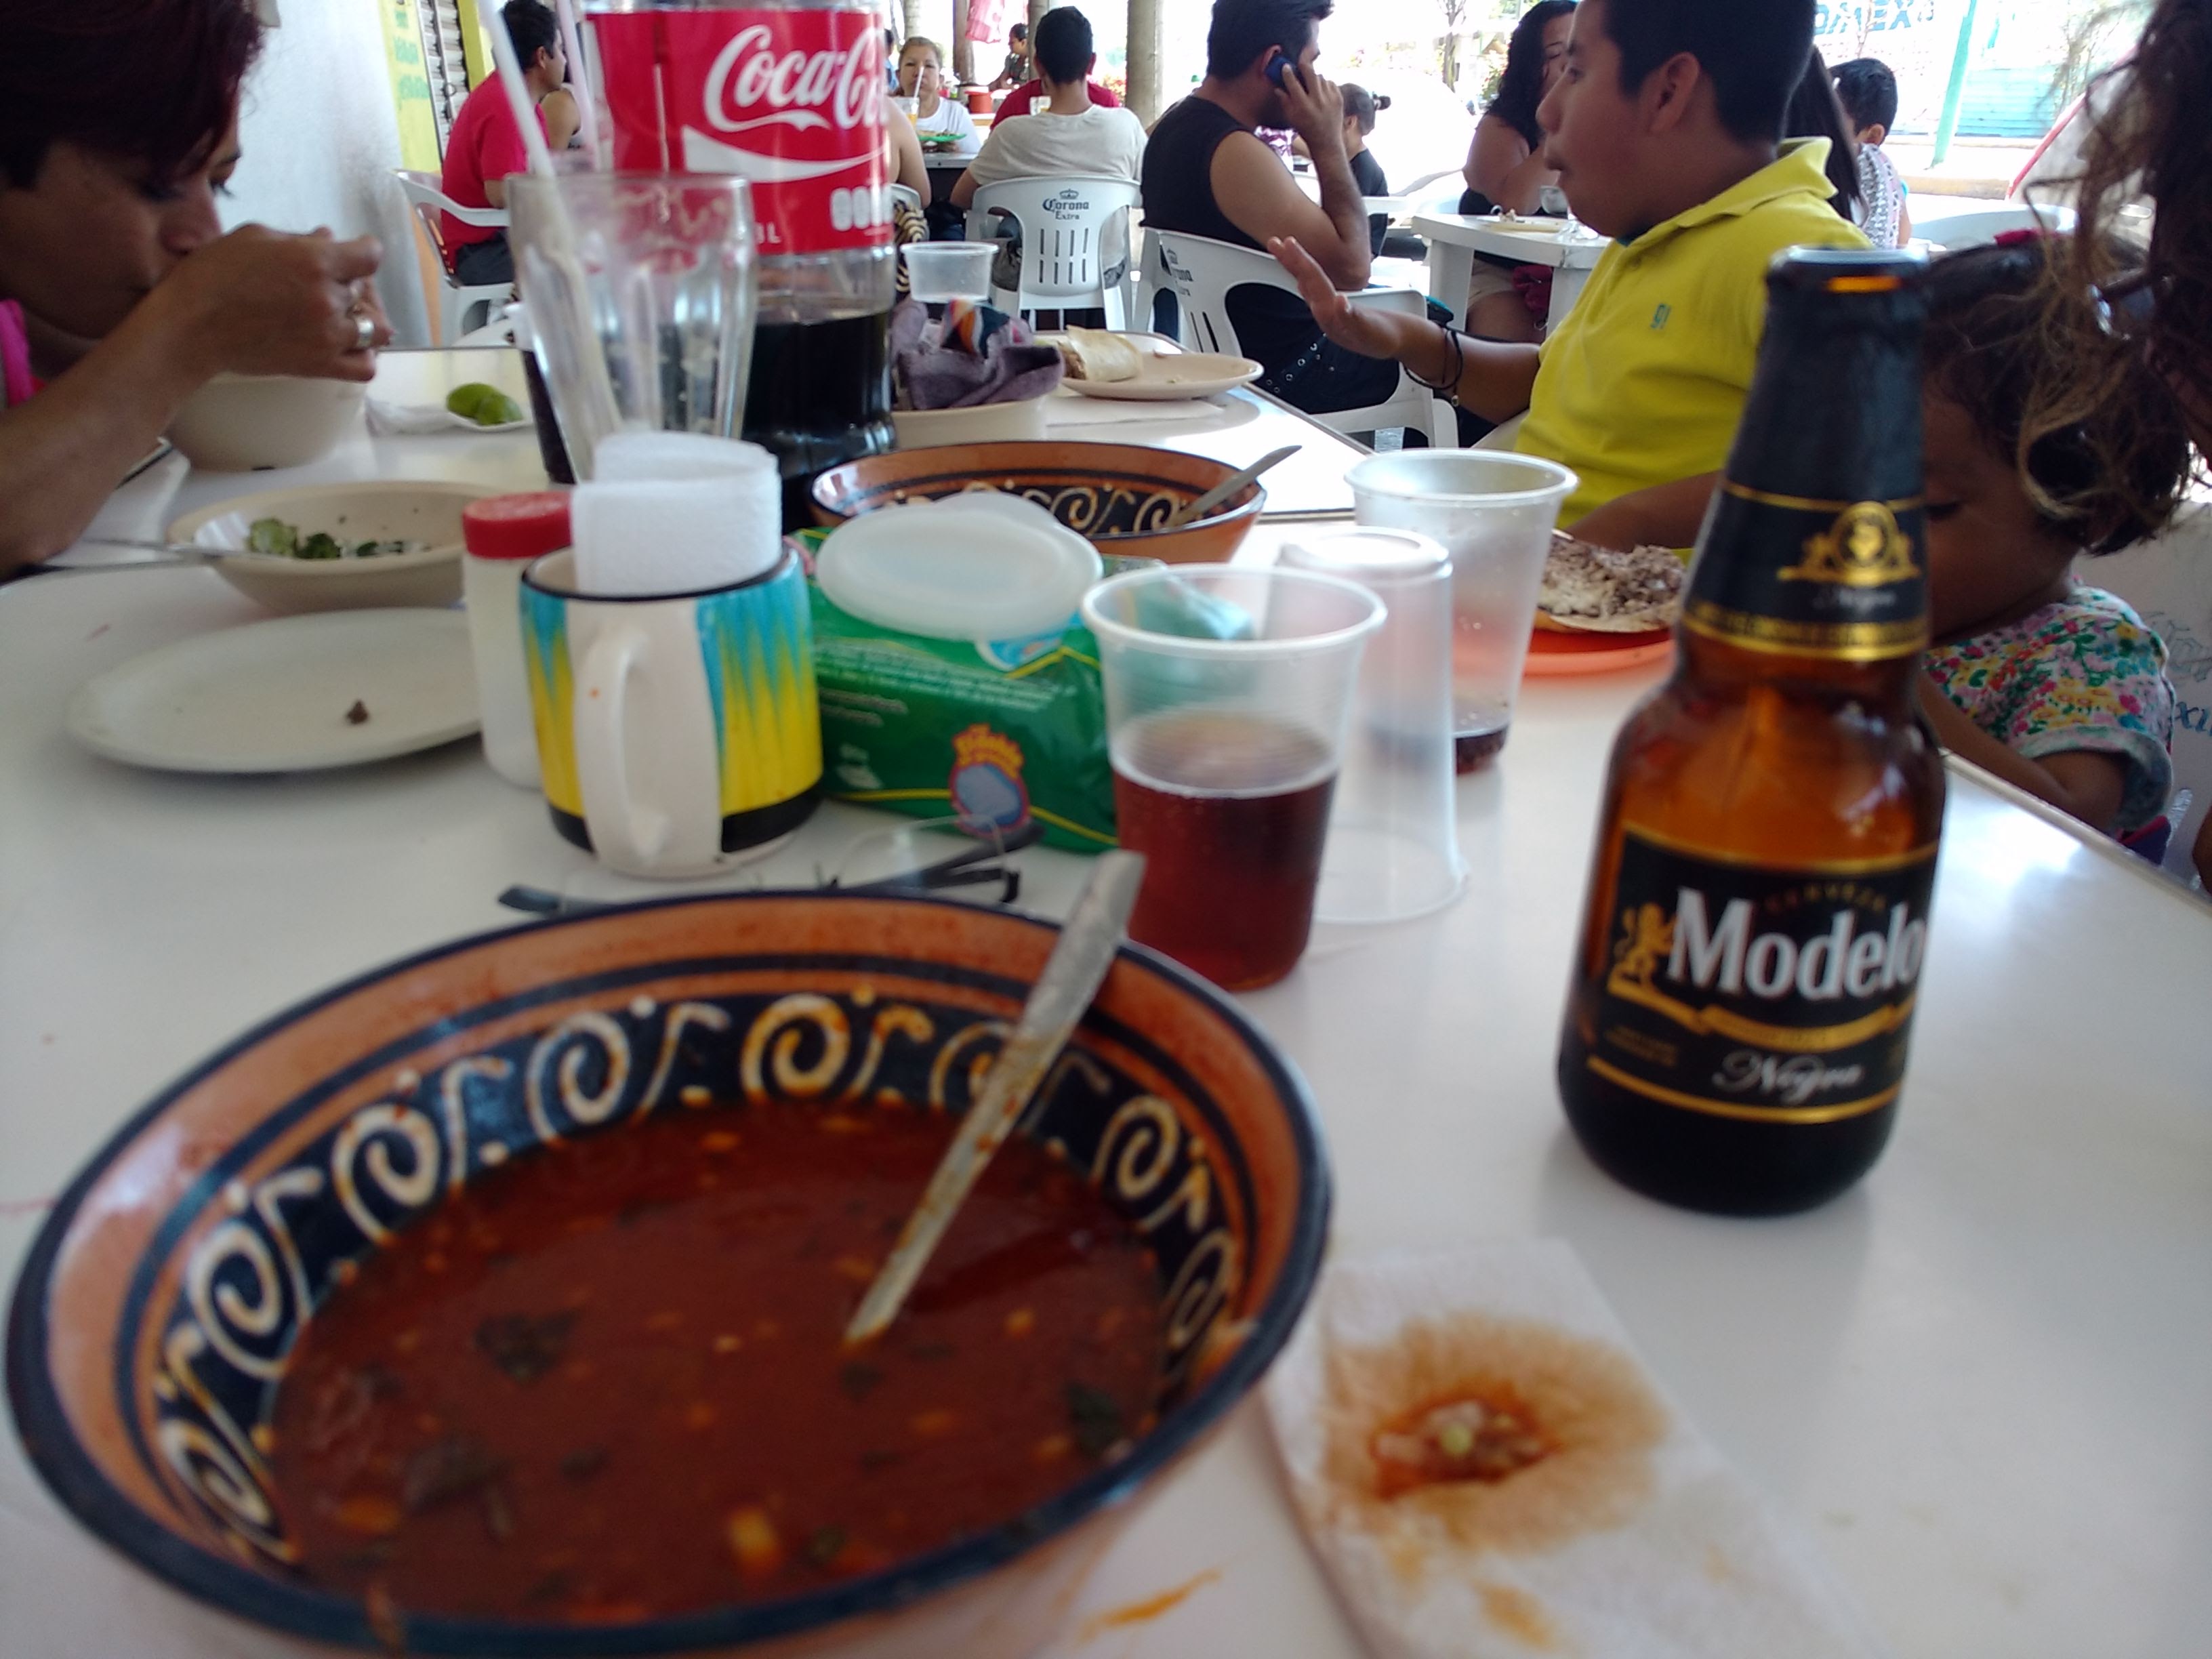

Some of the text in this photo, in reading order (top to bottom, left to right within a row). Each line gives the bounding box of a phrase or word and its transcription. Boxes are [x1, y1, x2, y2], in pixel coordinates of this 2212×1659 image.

[1042, 198, 1089, 213] Corona
[1055, 211, 1080, 220] Extra
[1666, 885, 1927, 1001] Modelo
